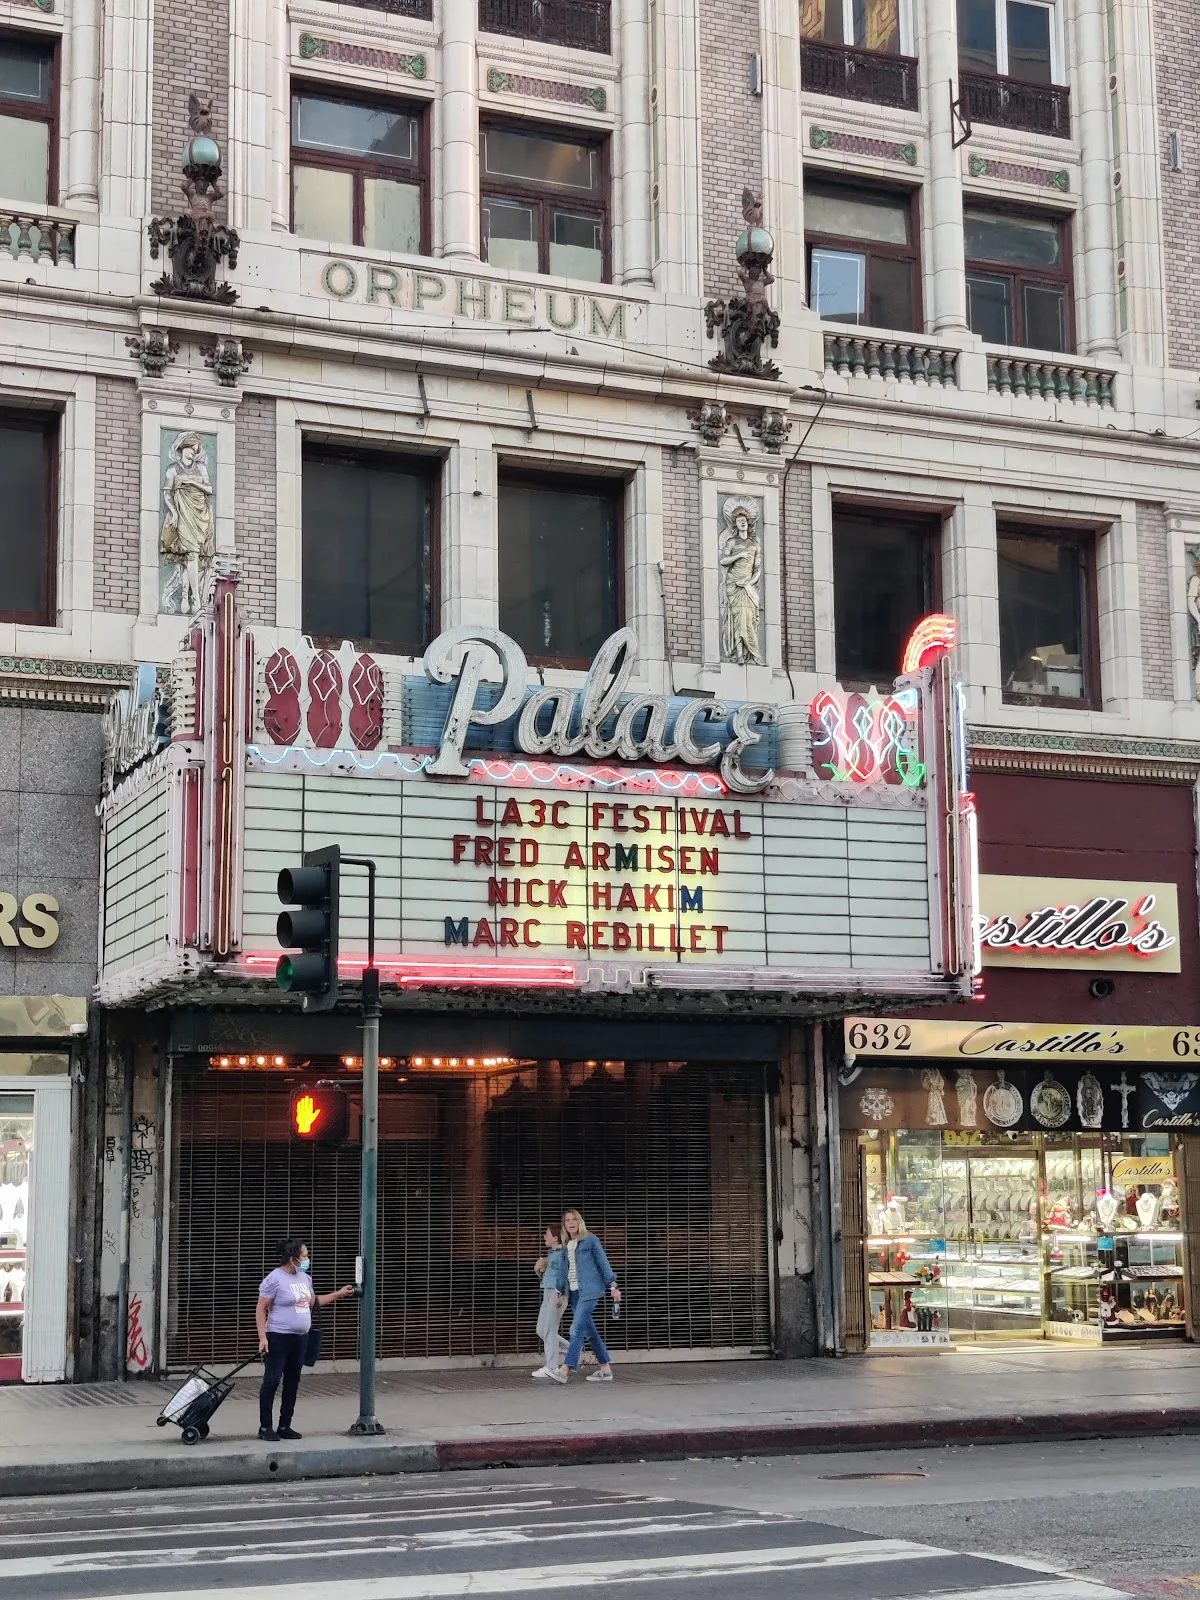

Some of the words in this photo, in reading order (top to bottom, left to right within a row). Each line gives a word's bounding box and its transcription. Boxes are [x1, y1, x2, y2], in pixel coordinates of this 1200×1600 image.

[321, 260, 627, 339] ORPHEUM
[423, 625, 781, 793] Palace
[476, 795, 571, 830] LA3C
[592, 802, 750, 839] FESTIVAL
[453, 834, 539, 867] FRED
[564, 841, 719, 875] ARMISEN
[488, 877, 567, 908] NICK
[592, 882, 704, 913] HAKIM
[444, 916, 541, 947] MARC
[567, 920, 729, 954] REBILLET
[849, 1022, 912, 1050] 632
[958, 1023, 1129, 1055] Castillo's
[1111, 1158, 1171, 1178] Castillo's
